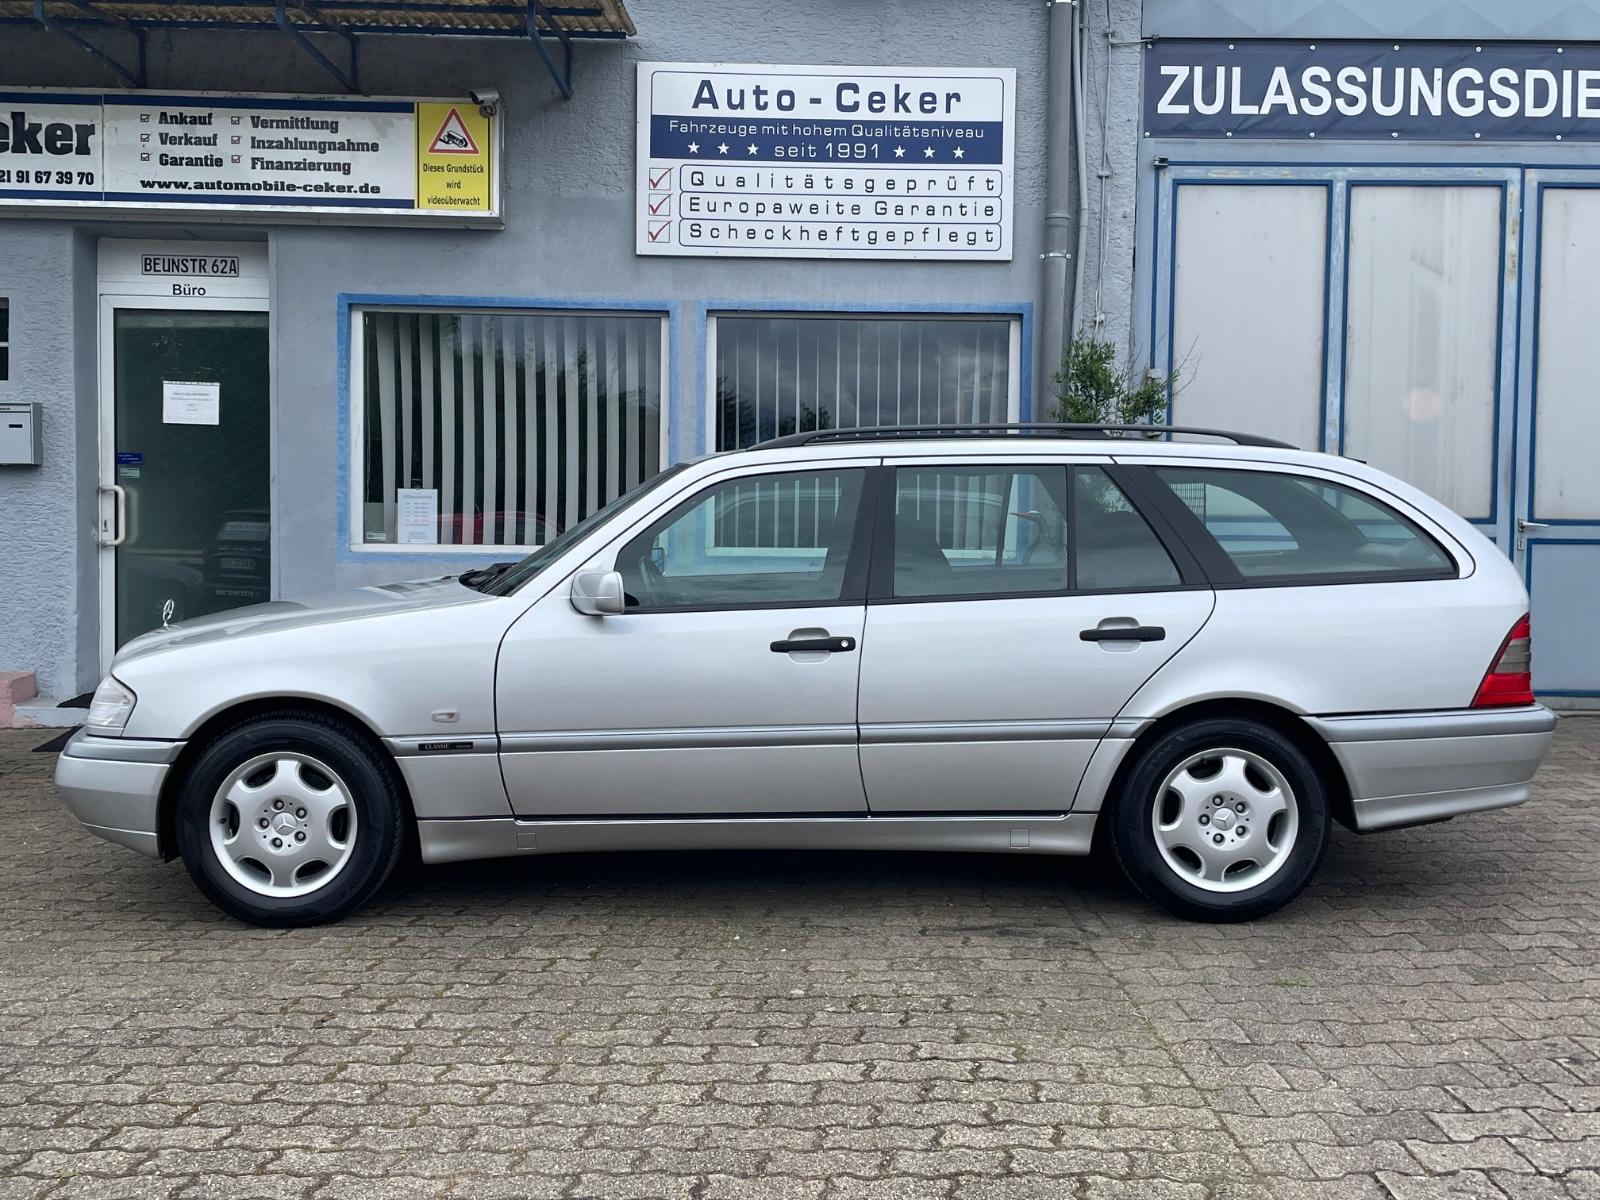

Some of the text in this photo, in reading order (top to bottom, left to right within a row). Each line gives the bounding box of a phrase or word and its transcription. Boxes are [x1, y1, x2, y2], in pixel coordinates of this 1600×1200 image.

[691, 79, 796, 112] Auto
[835, 82, 962, 114] Ceker
[1157, 66, 1600, 118] ZULASSUNGSDIE
[159, 112, 213, 125] Ankauf
[250, 115, 339, 133] Vermittlung
[669, 120, 984, 138] Fahrzeuge mit hohem Qualitätsniveau
[159, 132, 218, 146] Verkauf
[250, 136, 380, 154] Inzahlungnahme
[774, 143, 880, 159] seit 1991
[159, 153, 223, 167] Garantie
[250, 157, 351, 175] Finanzierung
[423, 163, 484, 173] Dieses Grundstück
[16, 169, 30, 183] 91
[34, 170, 52, 184] 67
[56, 171, 73, 185] 39
[77, 172, 94, 185] 70
[446, 180, 461, 189] wird
[690, 171, 995, 193] Qualitätsgeprüft
[140, 179, 381, 194] www.automobile-ceker.de
[427, 196, 480, 205] videoüberwacht
[689, 197, 994, 218] Europaweite Garantie
[690, 224, 994, 245] Scheckheftgepflegt
[211, 259, 237, 274] 62A
[172, 284, 206, 296] Büro
